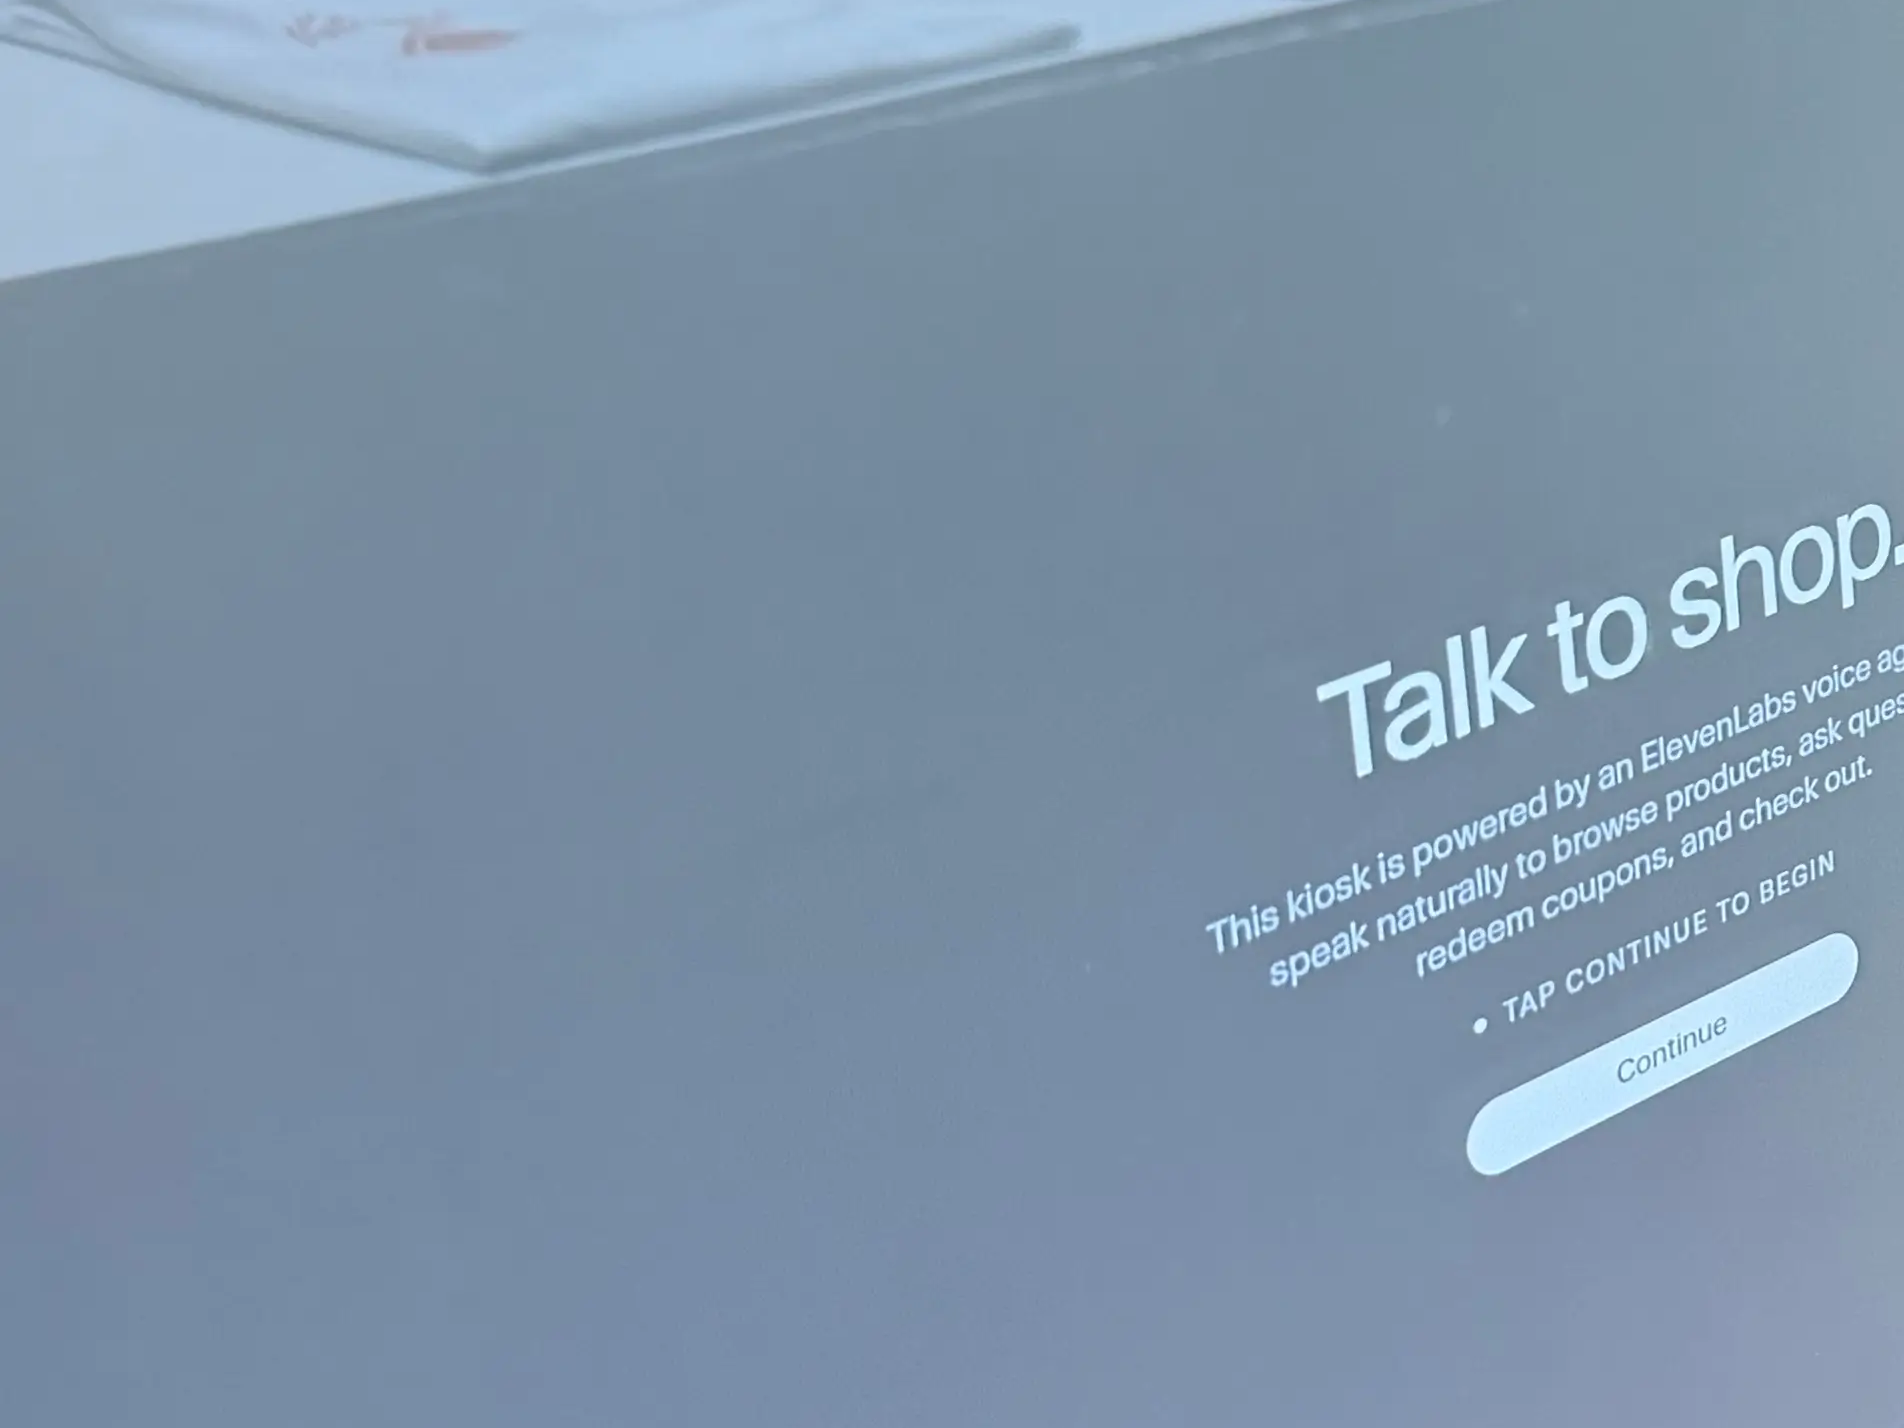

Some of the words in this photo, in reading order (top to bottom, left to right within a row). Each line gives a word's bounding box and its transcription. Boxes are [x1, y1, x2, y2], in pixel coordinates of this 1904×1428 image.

[1316, 626, 1536, 778] Talk
[1547, 596, 1648, 694] to
[1206, 905, 1280, 954] This
[1287, 863, 1373, 924] kiosk
[1377, 852, 1406, 885] is
[1413, 786, 1548, 878] powered
[1555, 774, 1591, 810] by
[1598, 758, 1634, 792] an
[1641, 691, 1797, 774] ElevenLabs
[1802, 660, 1872, 704] voice
[1270, 921, 1371, 988] speak
[1377, 863, 1509, 942] naturally
[1515, 849, 1547, 880] to
[1553, 801, 1659, 865] browse
[1666, 746, 1793, 823] products,
[1799, 717, 1844, 758] ask
[1417, 906, 1535, 978] redeem
[1542, 848, 1675, 920] coupons,
[1681, 810, 1733, 858] and
[1739, 776, 1820, 831] check
[1825, 756, 1873, 793] out.
[1502, 981, 1556, 1023] TAP
[1566, 909, 1708, 995] CONTINUE
[1716, 891, 1750, 924] TO
[1760, 851, 1835, 905] BEGIN
[1616, 1014, 1729, 1085] Continue
